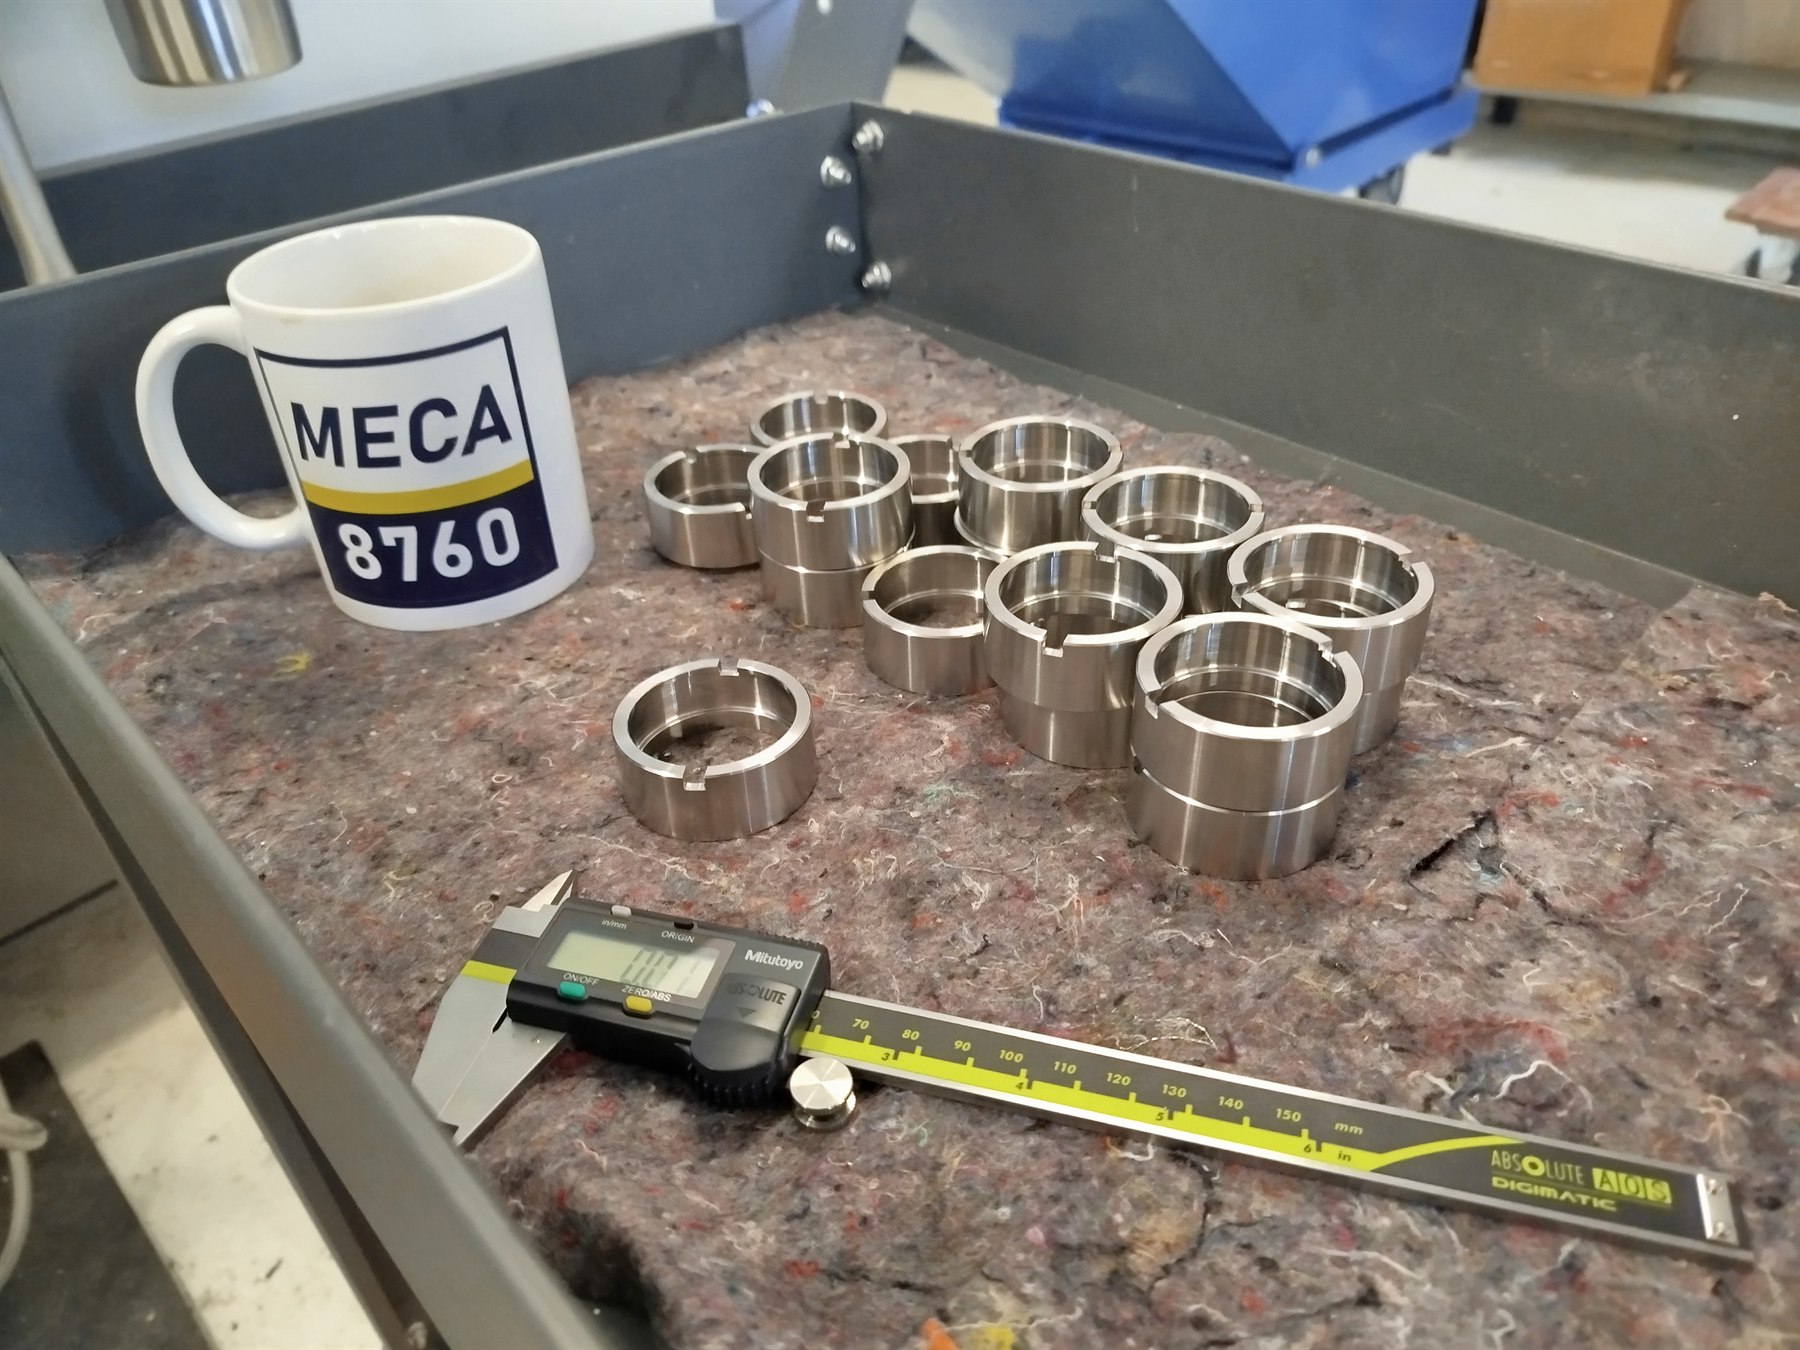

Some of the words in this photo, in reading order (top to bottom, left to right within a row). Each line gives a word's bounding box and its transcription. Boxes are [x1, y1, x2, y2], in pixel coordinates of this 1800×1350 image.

[290, 384, 513, 468] MECA
[338, 507, 520, 582] 8760
[601, 919, 627, 930] in/mm
[661, 930, 694, 943] ORIGIN
[745, 949, 804, 970] Mitutoyo
[563, 972, 599, 986] ON/OFF
[621, 985, 672, 1002] ZERO/ABS
[852, 1018, 870, 1030] 70
[902, 1029, 920, 1041] 80
[954, 1040, 971, 1052] 90
[1000, 1050, 1024, 1063] 100
[1053, 1061, 1077, 1075] 110
[1106, 1072, 1131, 1086] 120
[1162, 1084, 1187, 1098] 130
[1218, 1096, 1244, 1110] 140
[1276, 1108, 1302, 1122] 150
[1334, 1122, 1363, 1135] mm
[881, 1051, 891, 1062] 3
[1015, 1081, 1024, 1091] 4
[1155, 1111, 1165, 1122] 5
[1303, 1143, 1312, 1154] 6
[1337, 1150, 1351, 1162] in
[1491, 1150, 1584, 1185] ABSOLUTE
[1492, 1176, 1617, 1212] DIGIMATIC
